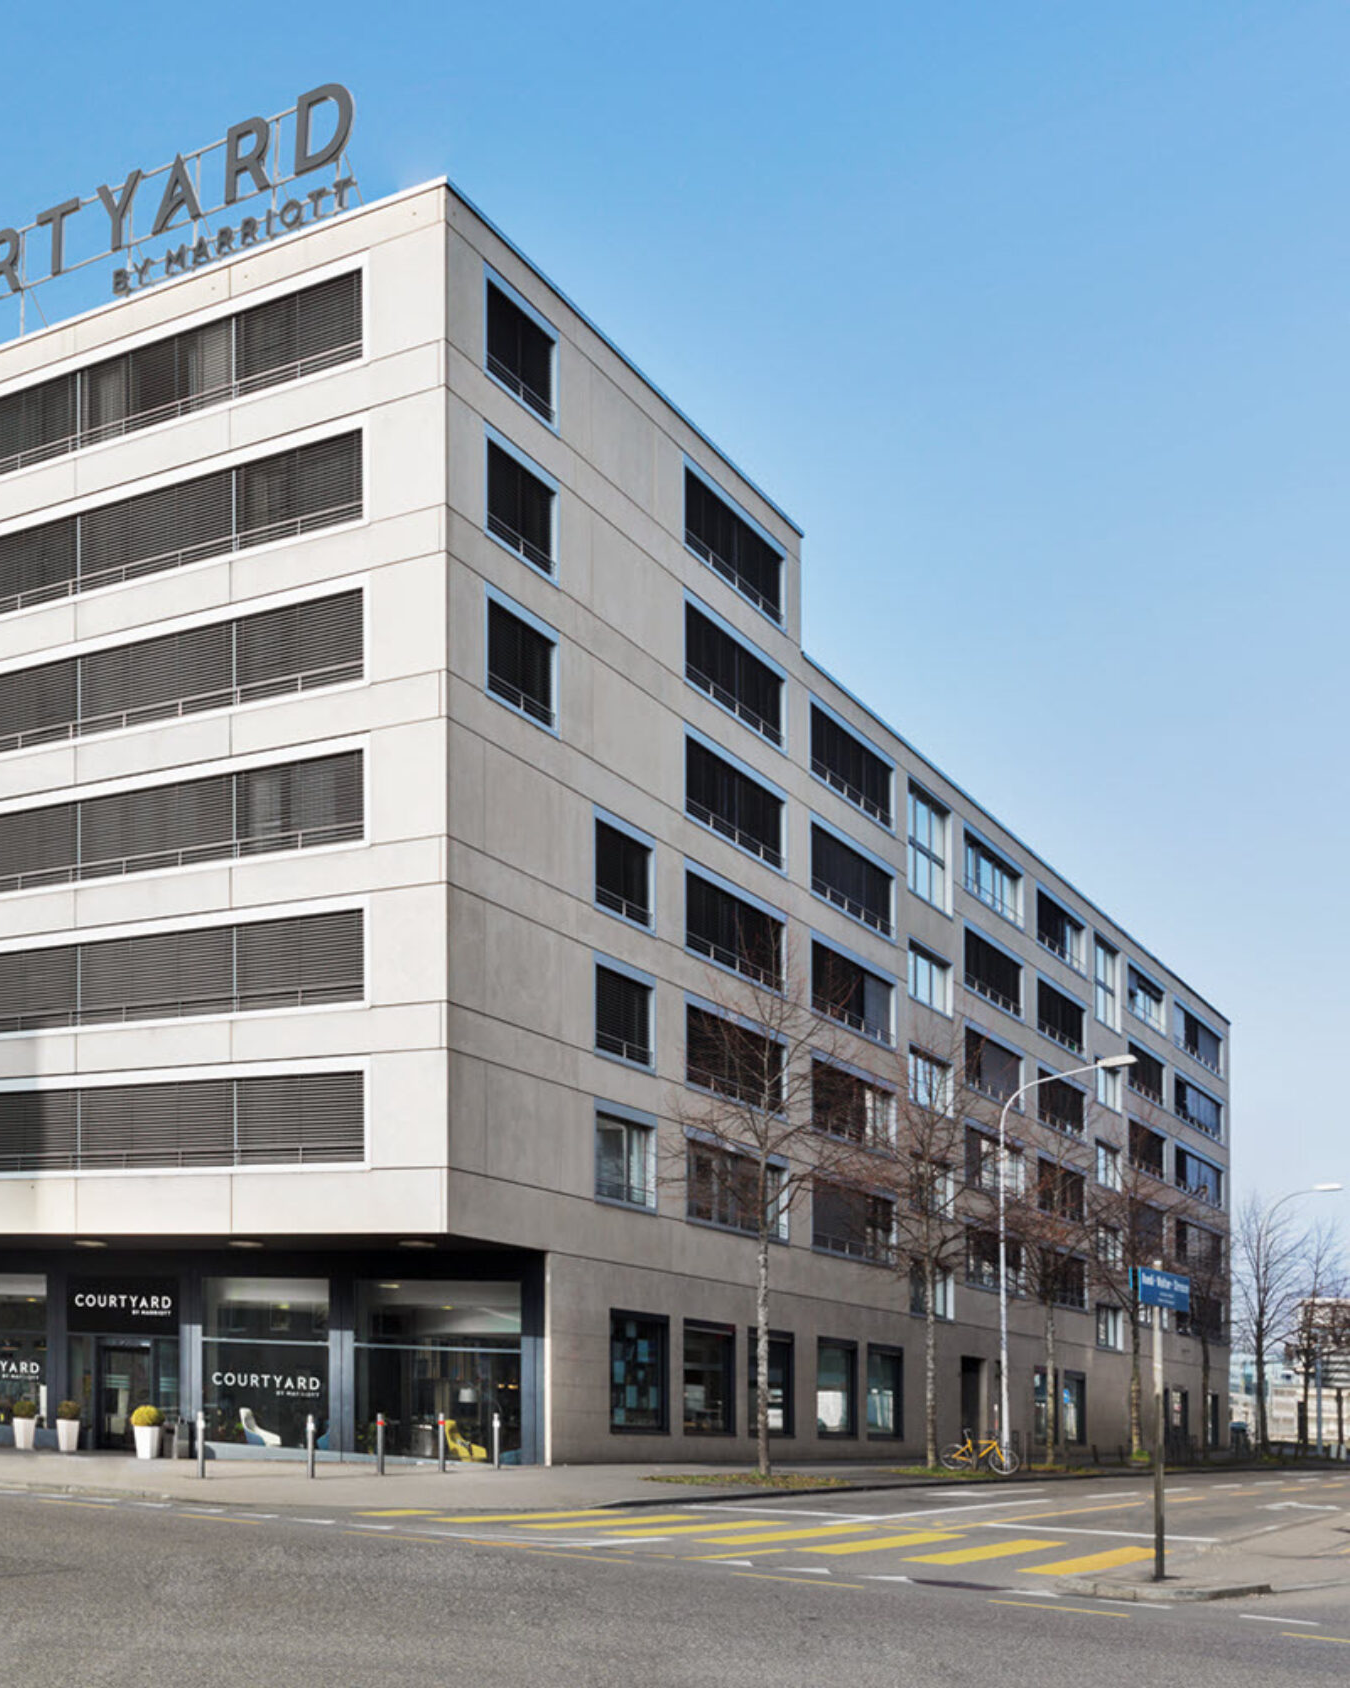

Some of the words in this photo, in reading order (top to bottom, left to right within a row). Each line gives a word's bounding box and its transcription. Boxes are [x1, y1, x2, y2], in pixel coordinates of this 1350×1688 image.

[112, 258, 152, 297] BY
[165, 176, 358, 276] MARRIOTT
[74, 1293, 172, 1309] COURTYARD
[211, 1371, 321, 1390] COURTYARD
